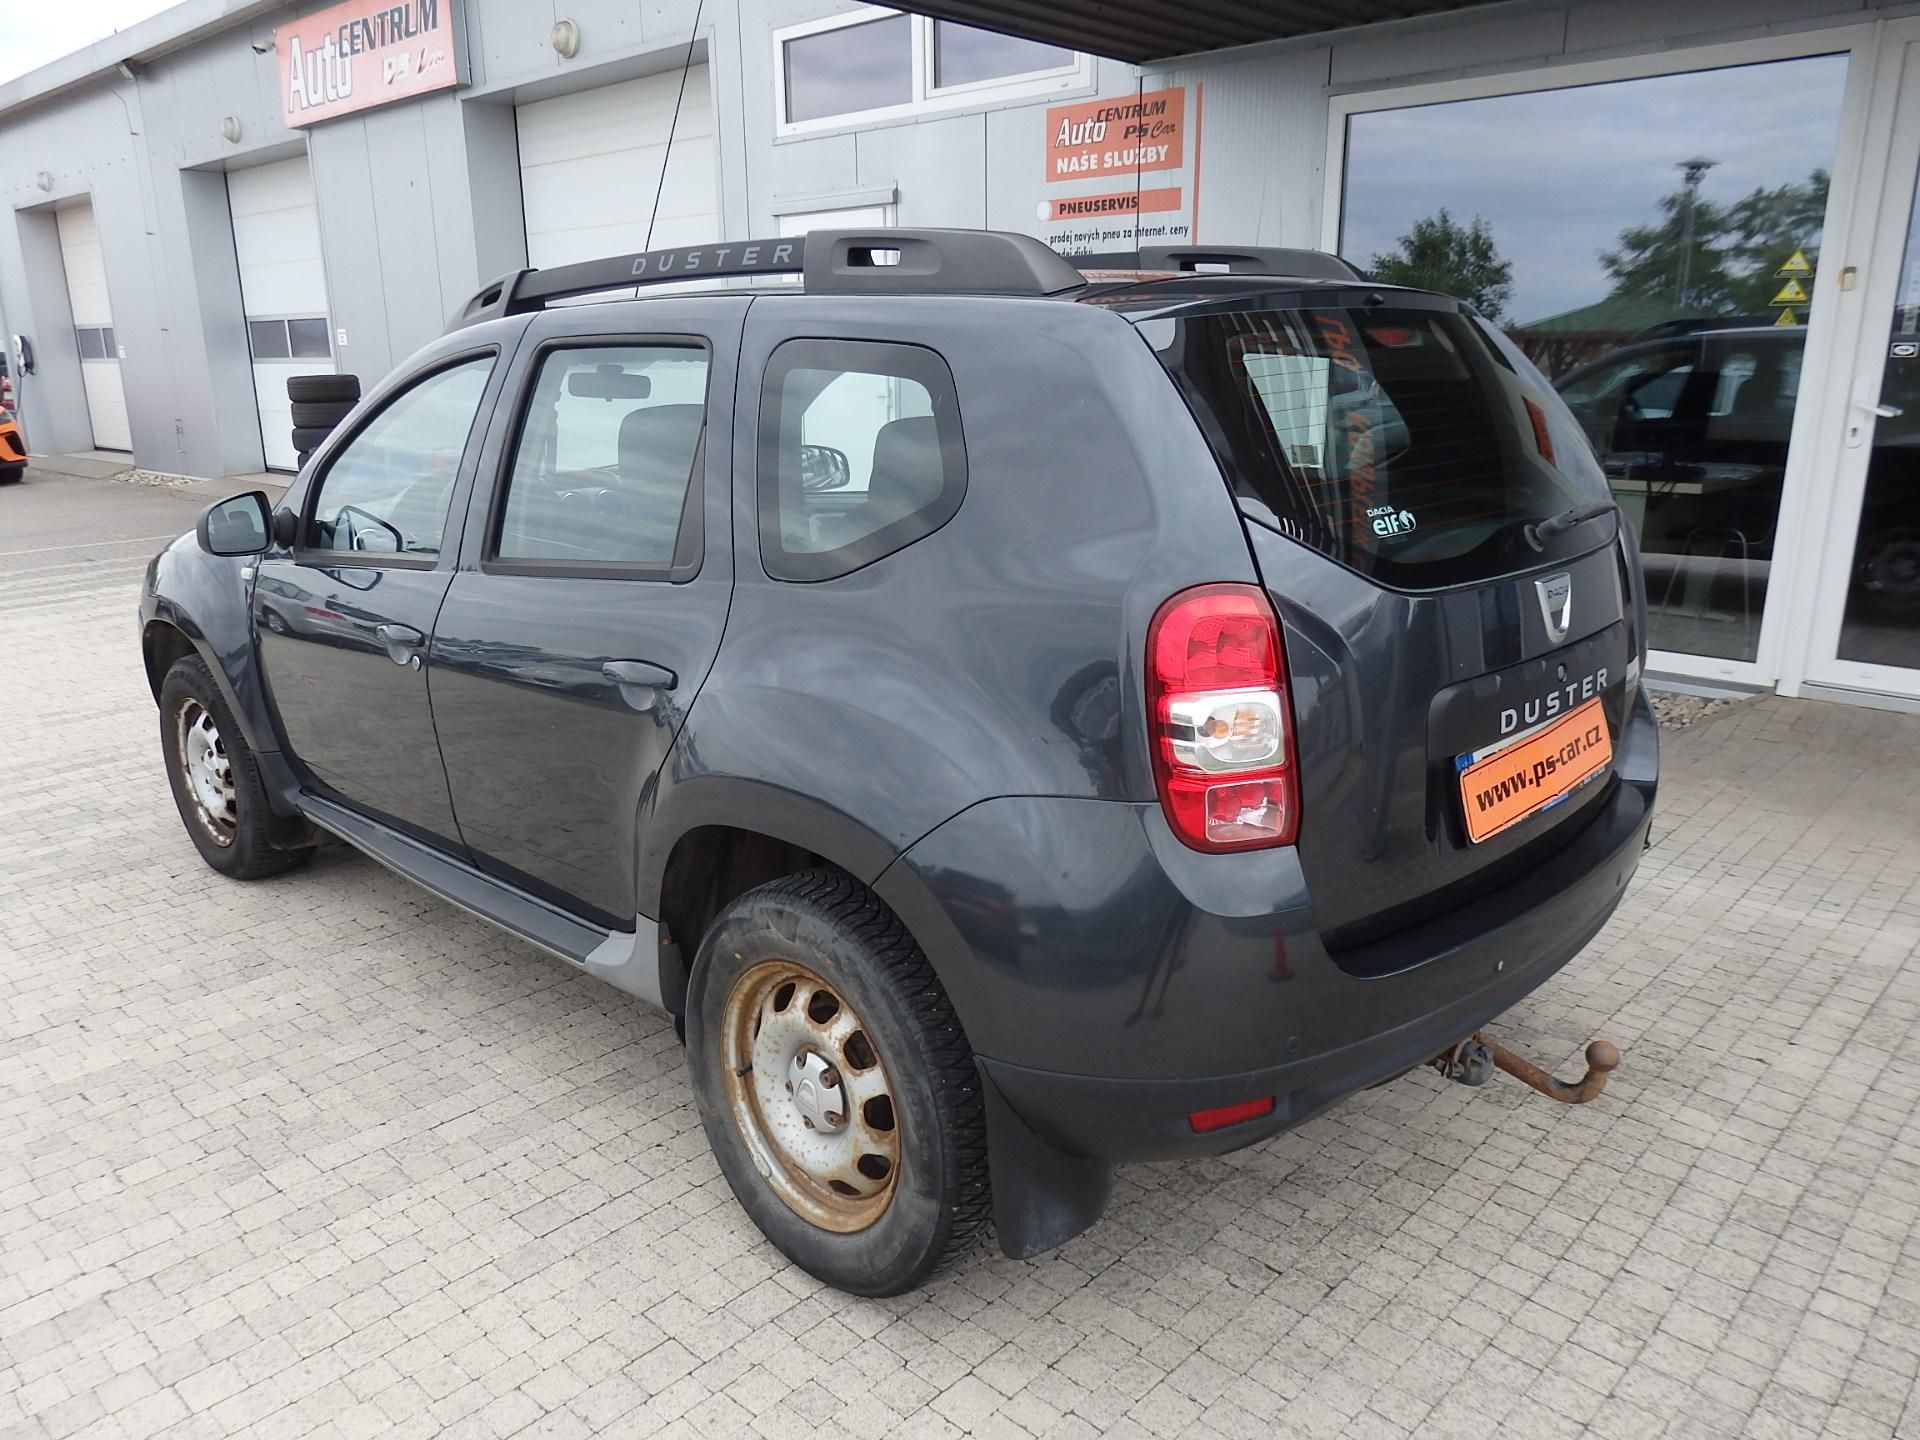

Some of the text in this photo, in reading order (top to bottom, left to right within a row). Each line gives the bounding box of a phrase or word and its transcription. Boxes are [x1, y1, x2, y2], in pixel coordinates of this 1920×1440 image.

[288, 33, 353, 114] Auto
[339, 0, 438, 59] CENTRUM
[1055, 99, 1166, 148] Auto CENTRUM
[1123, 120, 1177, 140] PS Car
[1057, 143, 1169, 174] NAŠE SLUŽBY
[1059, 196, 1138, 215] PNEUSERVIS
[1050, 230, 1072, 246] prodej
[1074, 228, 1100, 244] nových
[1102, 229, 1121, 243] pneu
[1123, 229, 1132, 238] za
[1169, 224, 1189, 237] ceny
[631, 244, 793, 275] DUSTER
[1366, 506, 1395, 517] DACIA
[1373, 514, 1399, 535] elf
[1500, 667, 1608, 735] DUSTER
[1475, 724, 1603, 812] www.ps-car.cz
